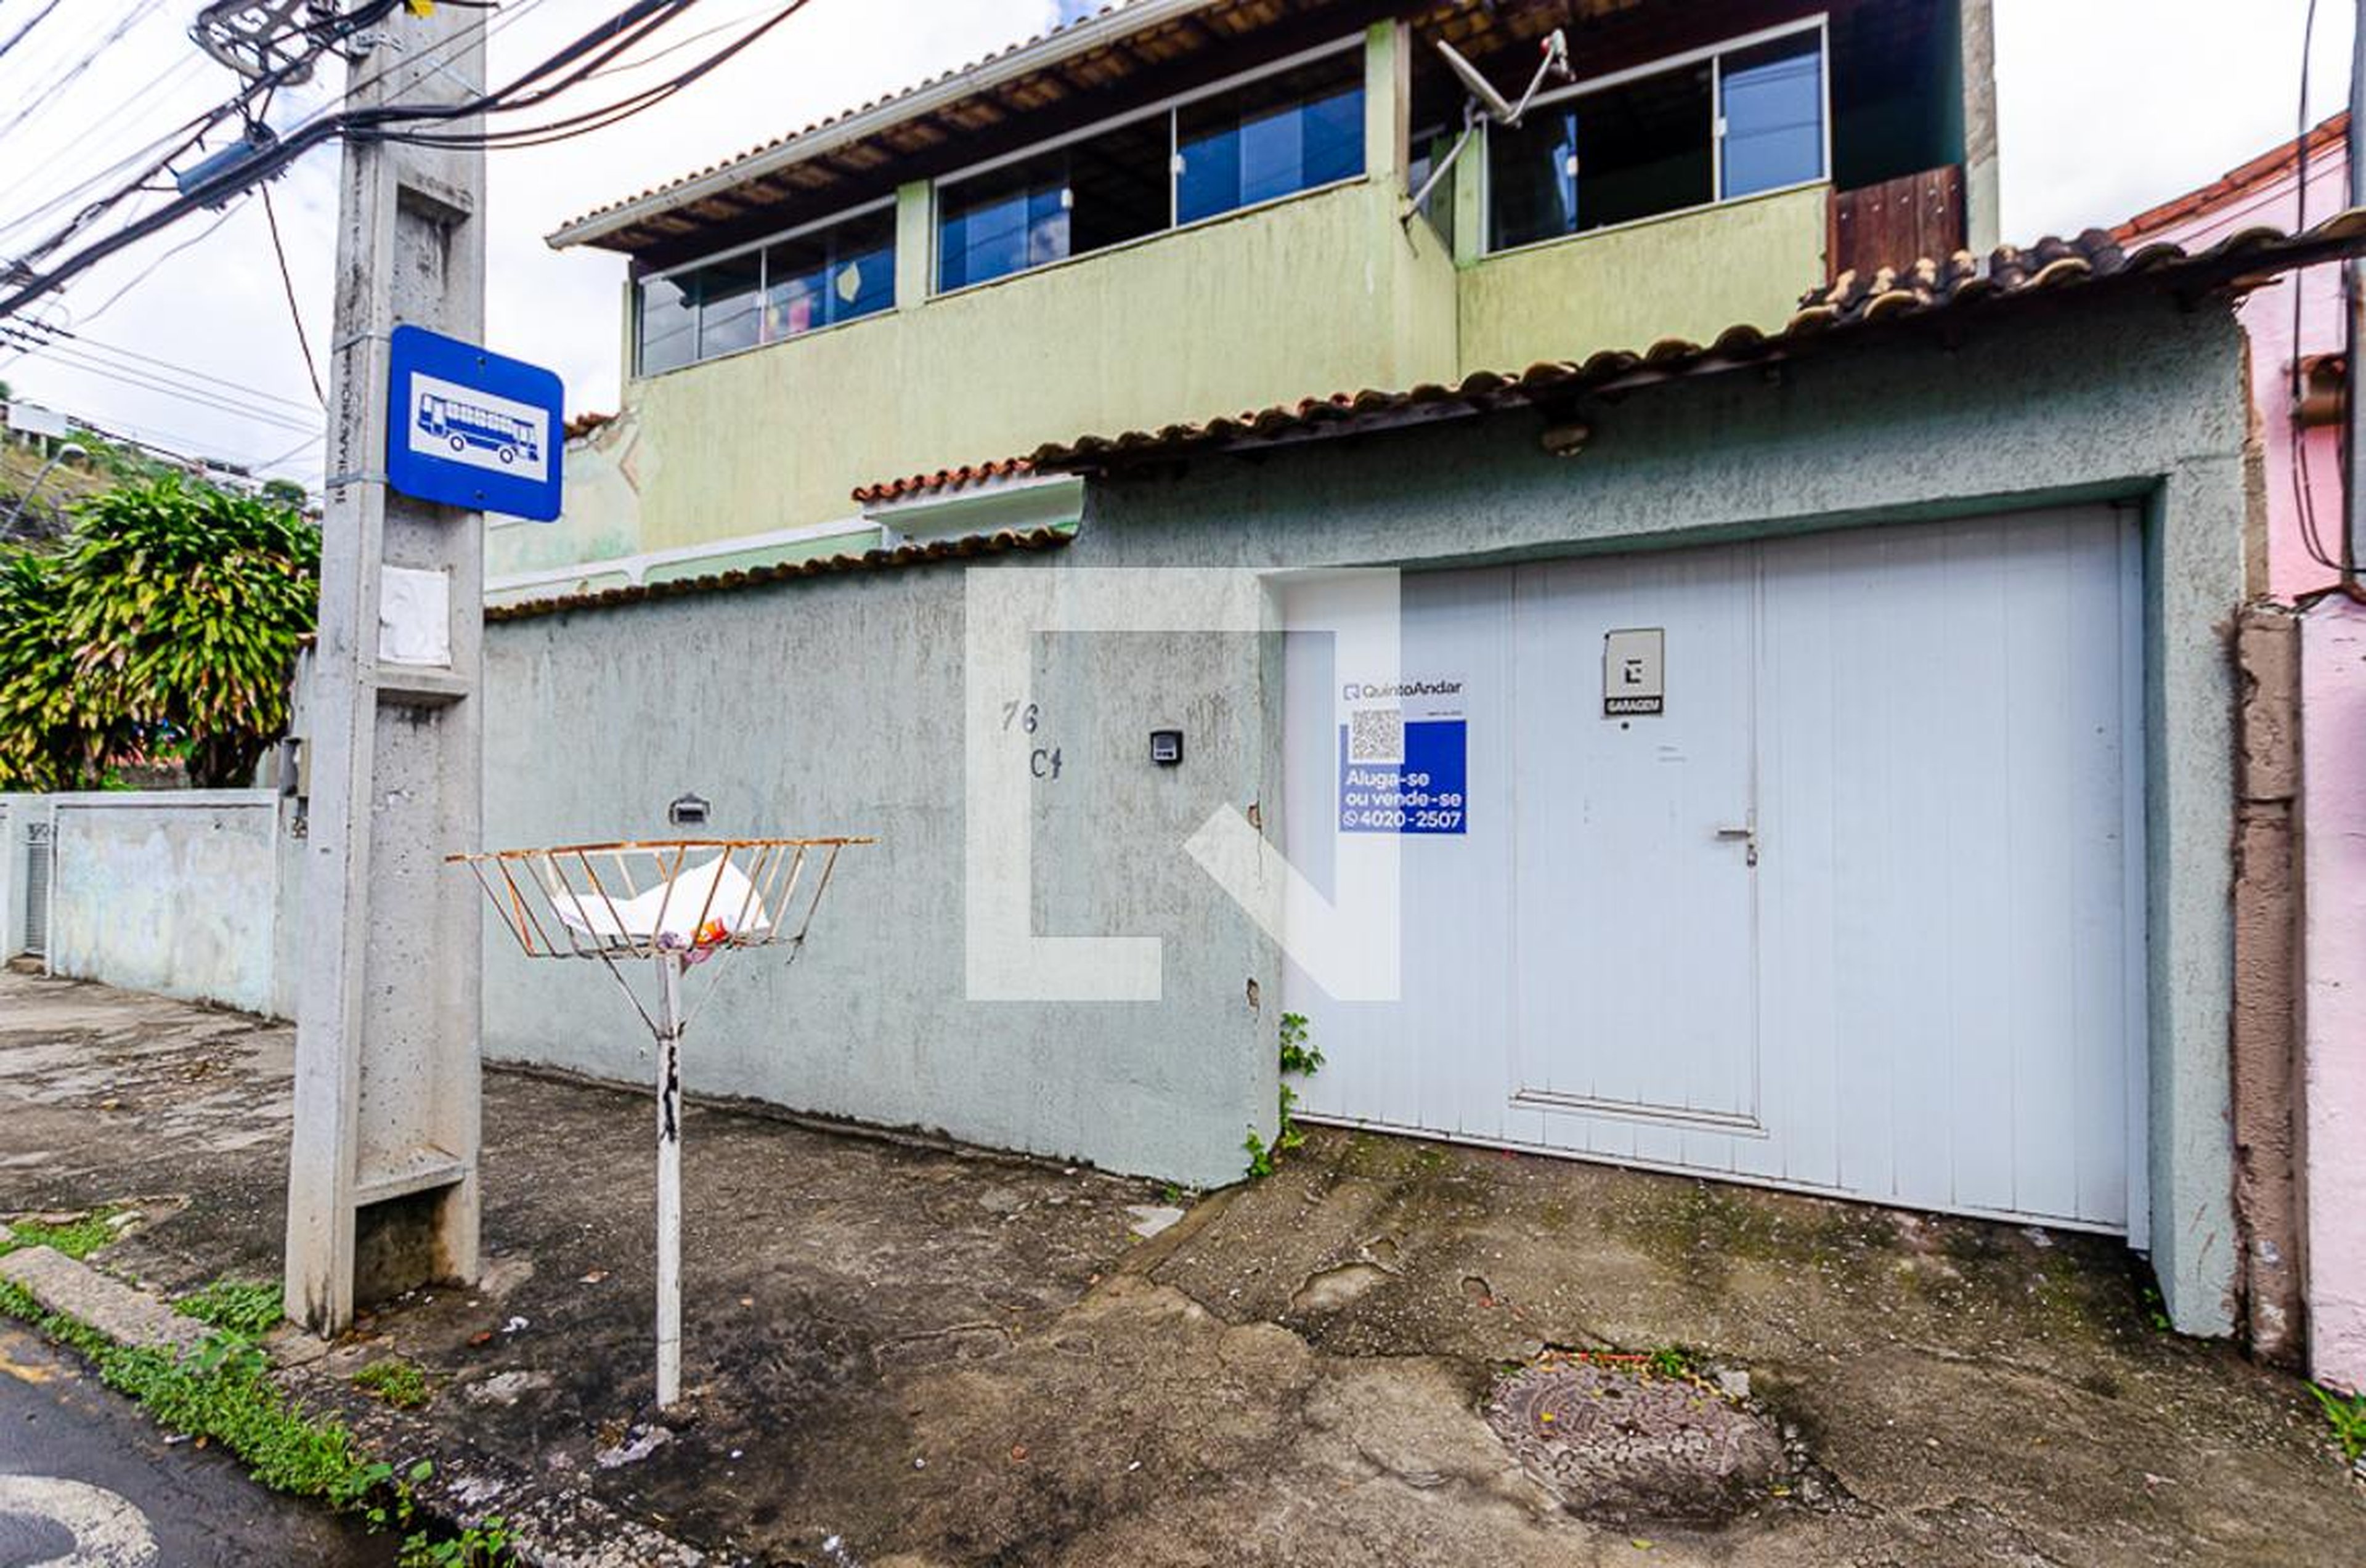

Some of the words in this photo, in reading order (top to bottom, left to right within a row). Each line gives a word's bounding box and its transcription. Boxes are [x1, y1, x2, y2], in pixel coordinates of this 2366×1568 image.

[1362, 680, 1462, 699] QuintoAndar
[1346, 770, 1430, 790] Aluga-se
[1345, 792, 1368, 806] ou
[1371, 791, 1462, 808] vende-se
[1360, 810, 1461, 828] 4020-2507
